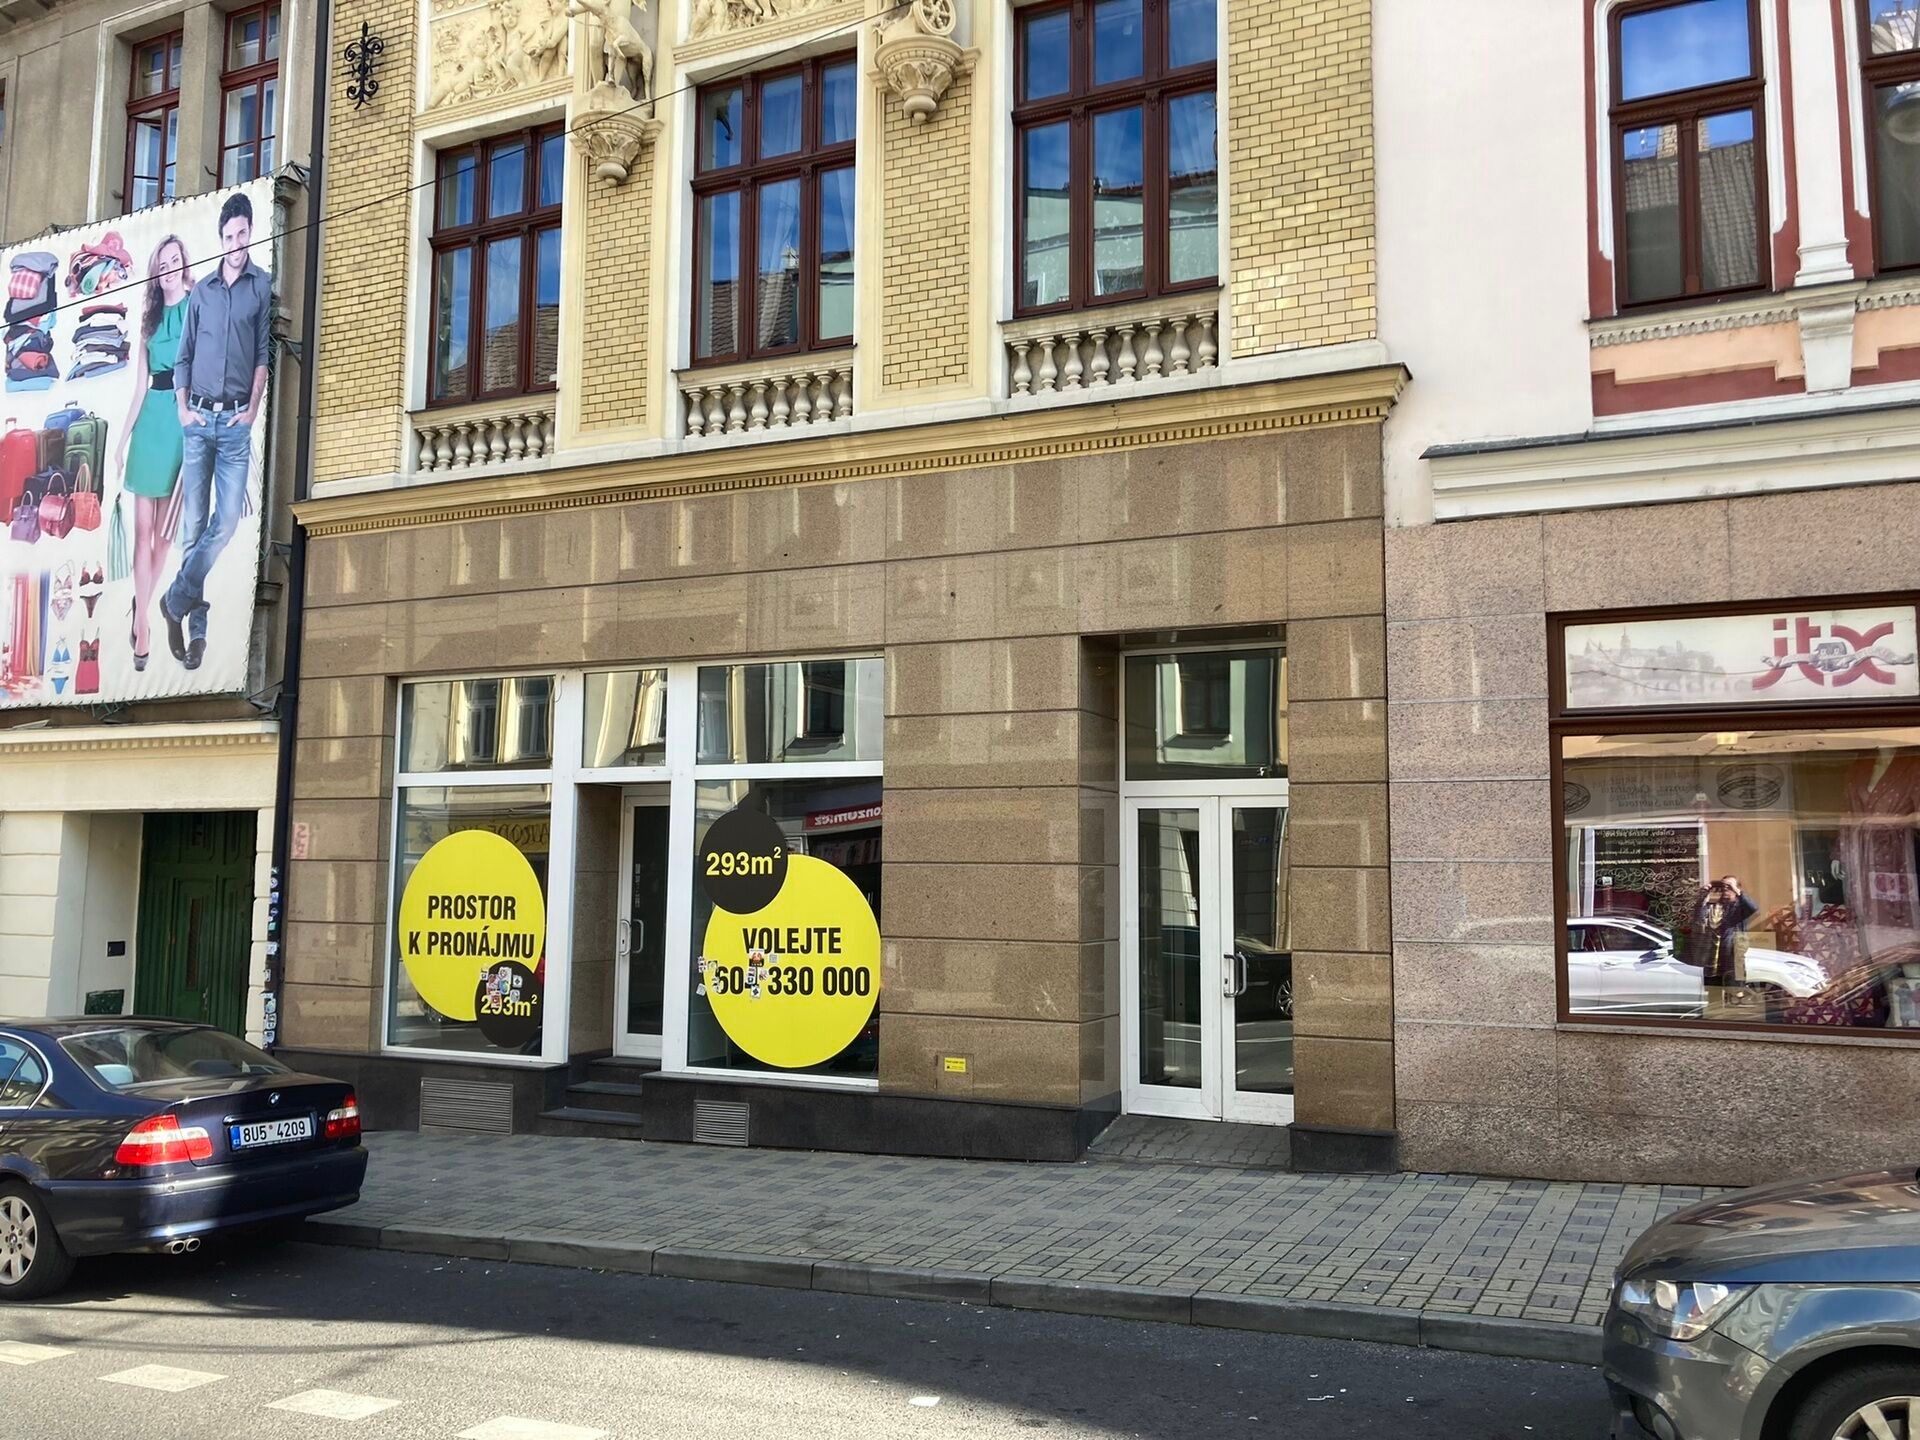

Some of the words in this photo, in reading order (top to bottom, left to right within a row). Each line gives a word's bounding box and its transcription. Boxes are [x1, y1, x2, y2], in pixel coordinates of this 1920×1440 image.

[427, 895, 516, 920] PROSTOR
[408, 931, 421, 955] K
[427, 925, 535, 959] PRONÁJMU
[742, 927, 842, 954] VOLEJTE
[715, 966, 759, 995] 60
[768, 966, 814, 996] 330
[823, 966, 870, 996] 000
[243, 1125, 267, 1143] 8U5
[277, 1120, 306, 1138] 4209
